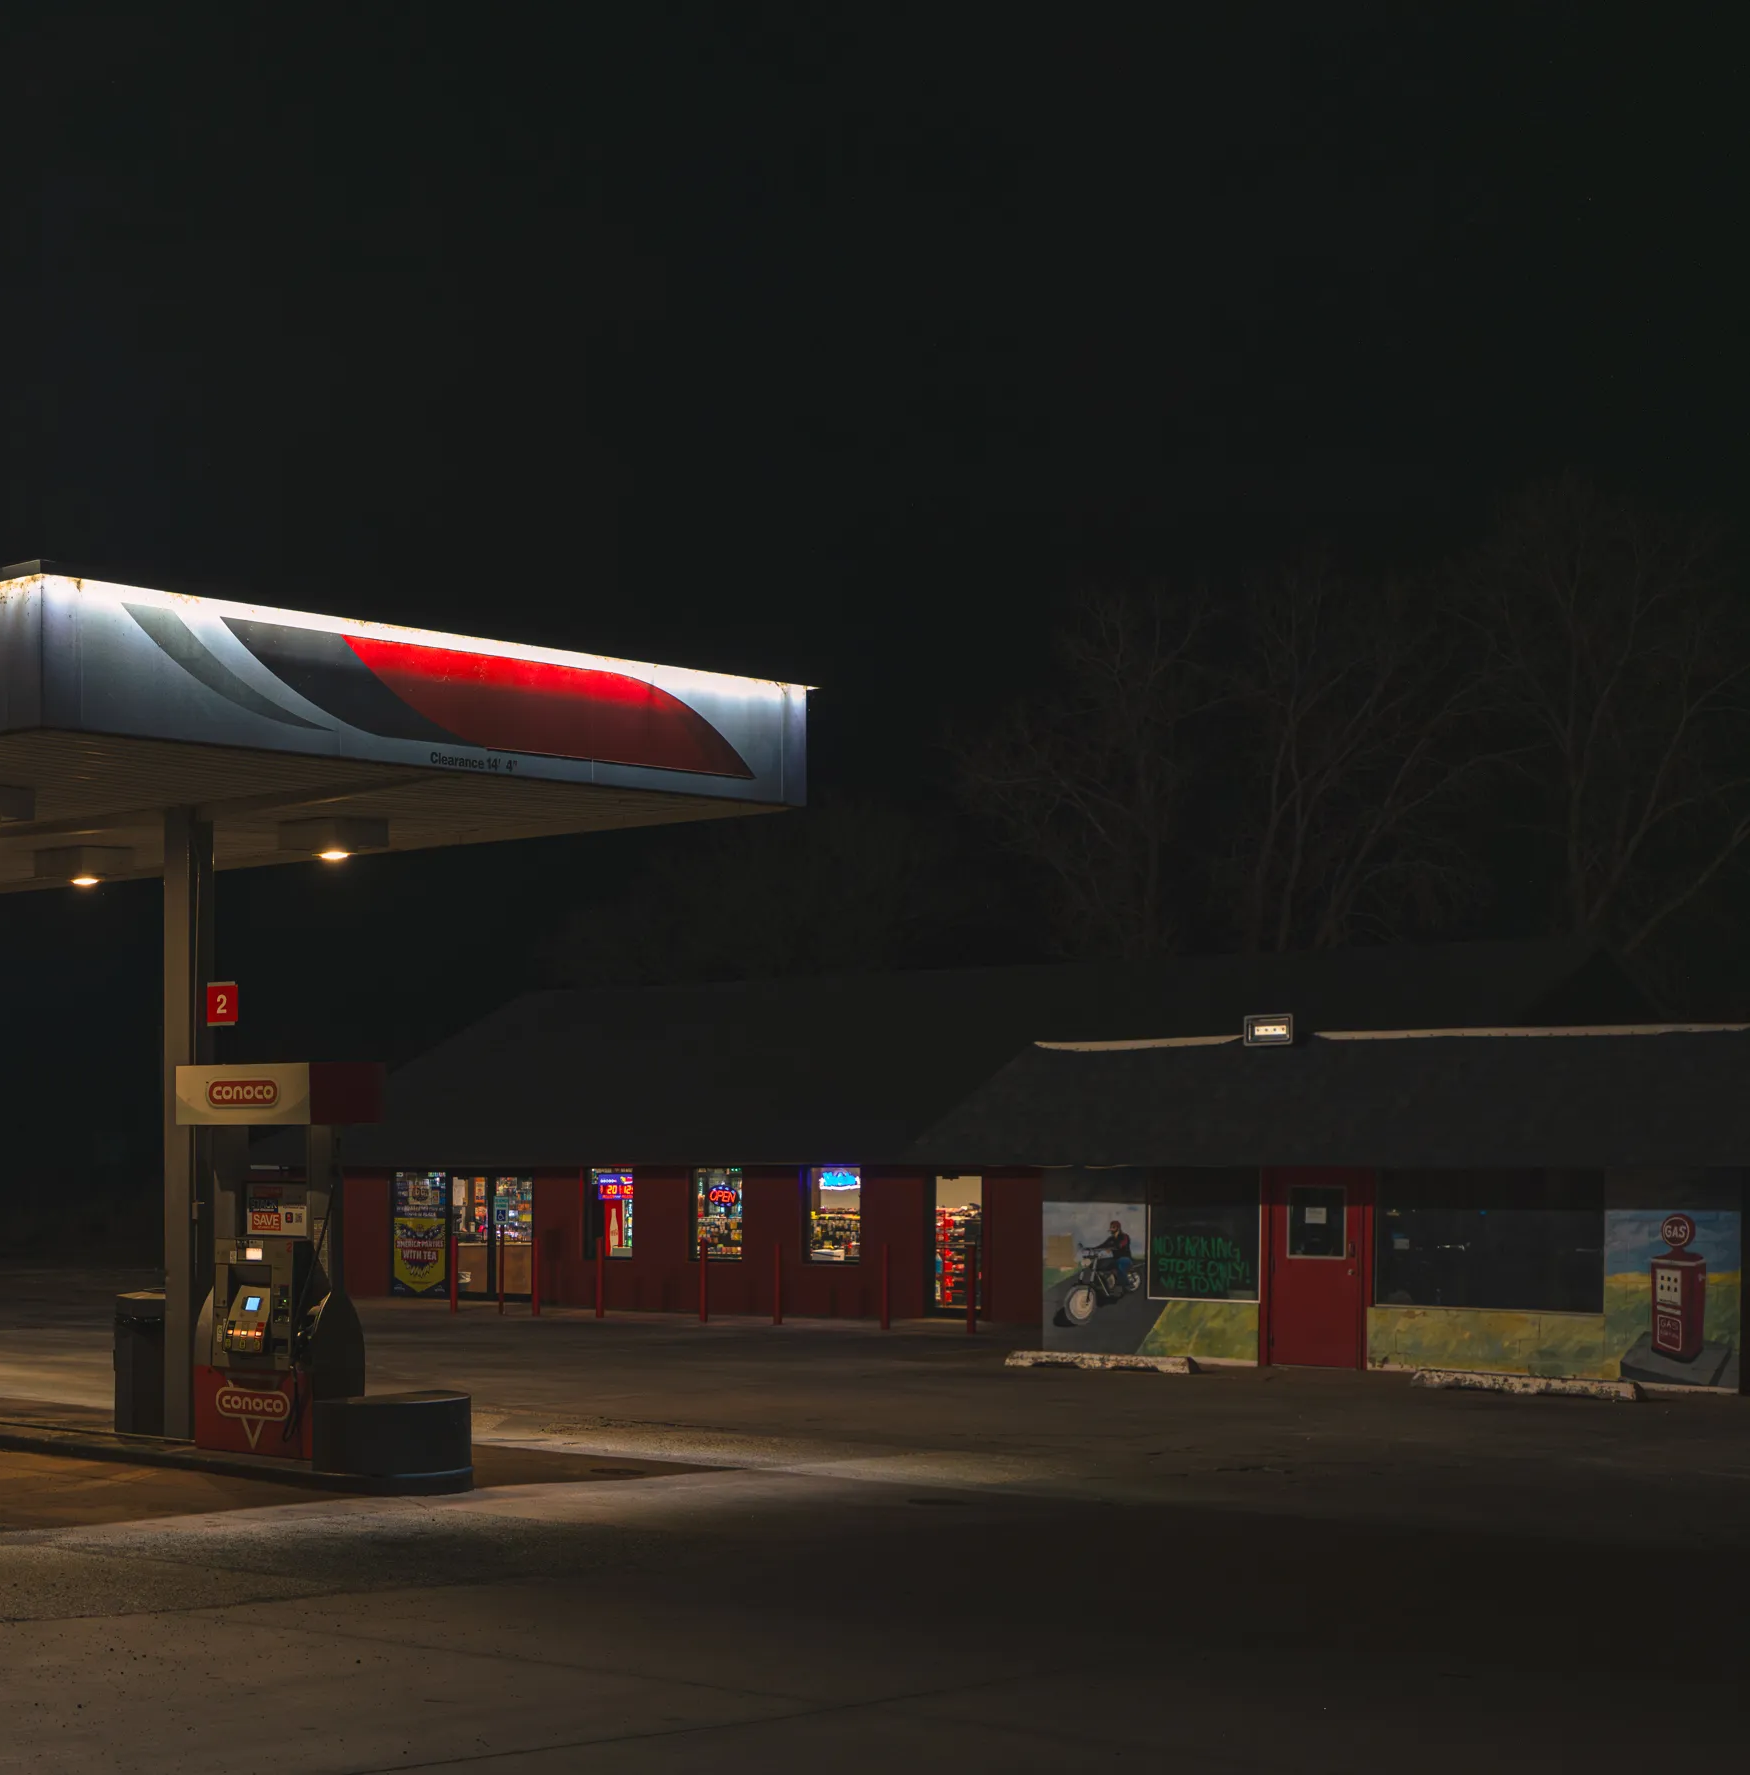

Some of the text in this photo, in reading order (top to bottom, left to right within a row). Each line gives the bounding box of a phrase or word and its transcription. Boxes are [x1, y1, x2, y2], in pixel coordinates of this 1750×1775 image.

[430, 751, 485, 770] Clearance
[216, 994, 228, 1014] 2
[709, 1190, 736, 1203] OPEN
[253, 1214, 280, 1226] SAVE
[1664, 1225, 1687, 1238] GAS
[403, 1250, 437, 1260] WITH TEA
[1154, 1235, 1241, 1262] NO PARKING
[1158, 1258, 1206, 1276] STORE
[1160, 1275, 1187, 1290] WE
[1660, 1319, 1679, 1331] GAS
